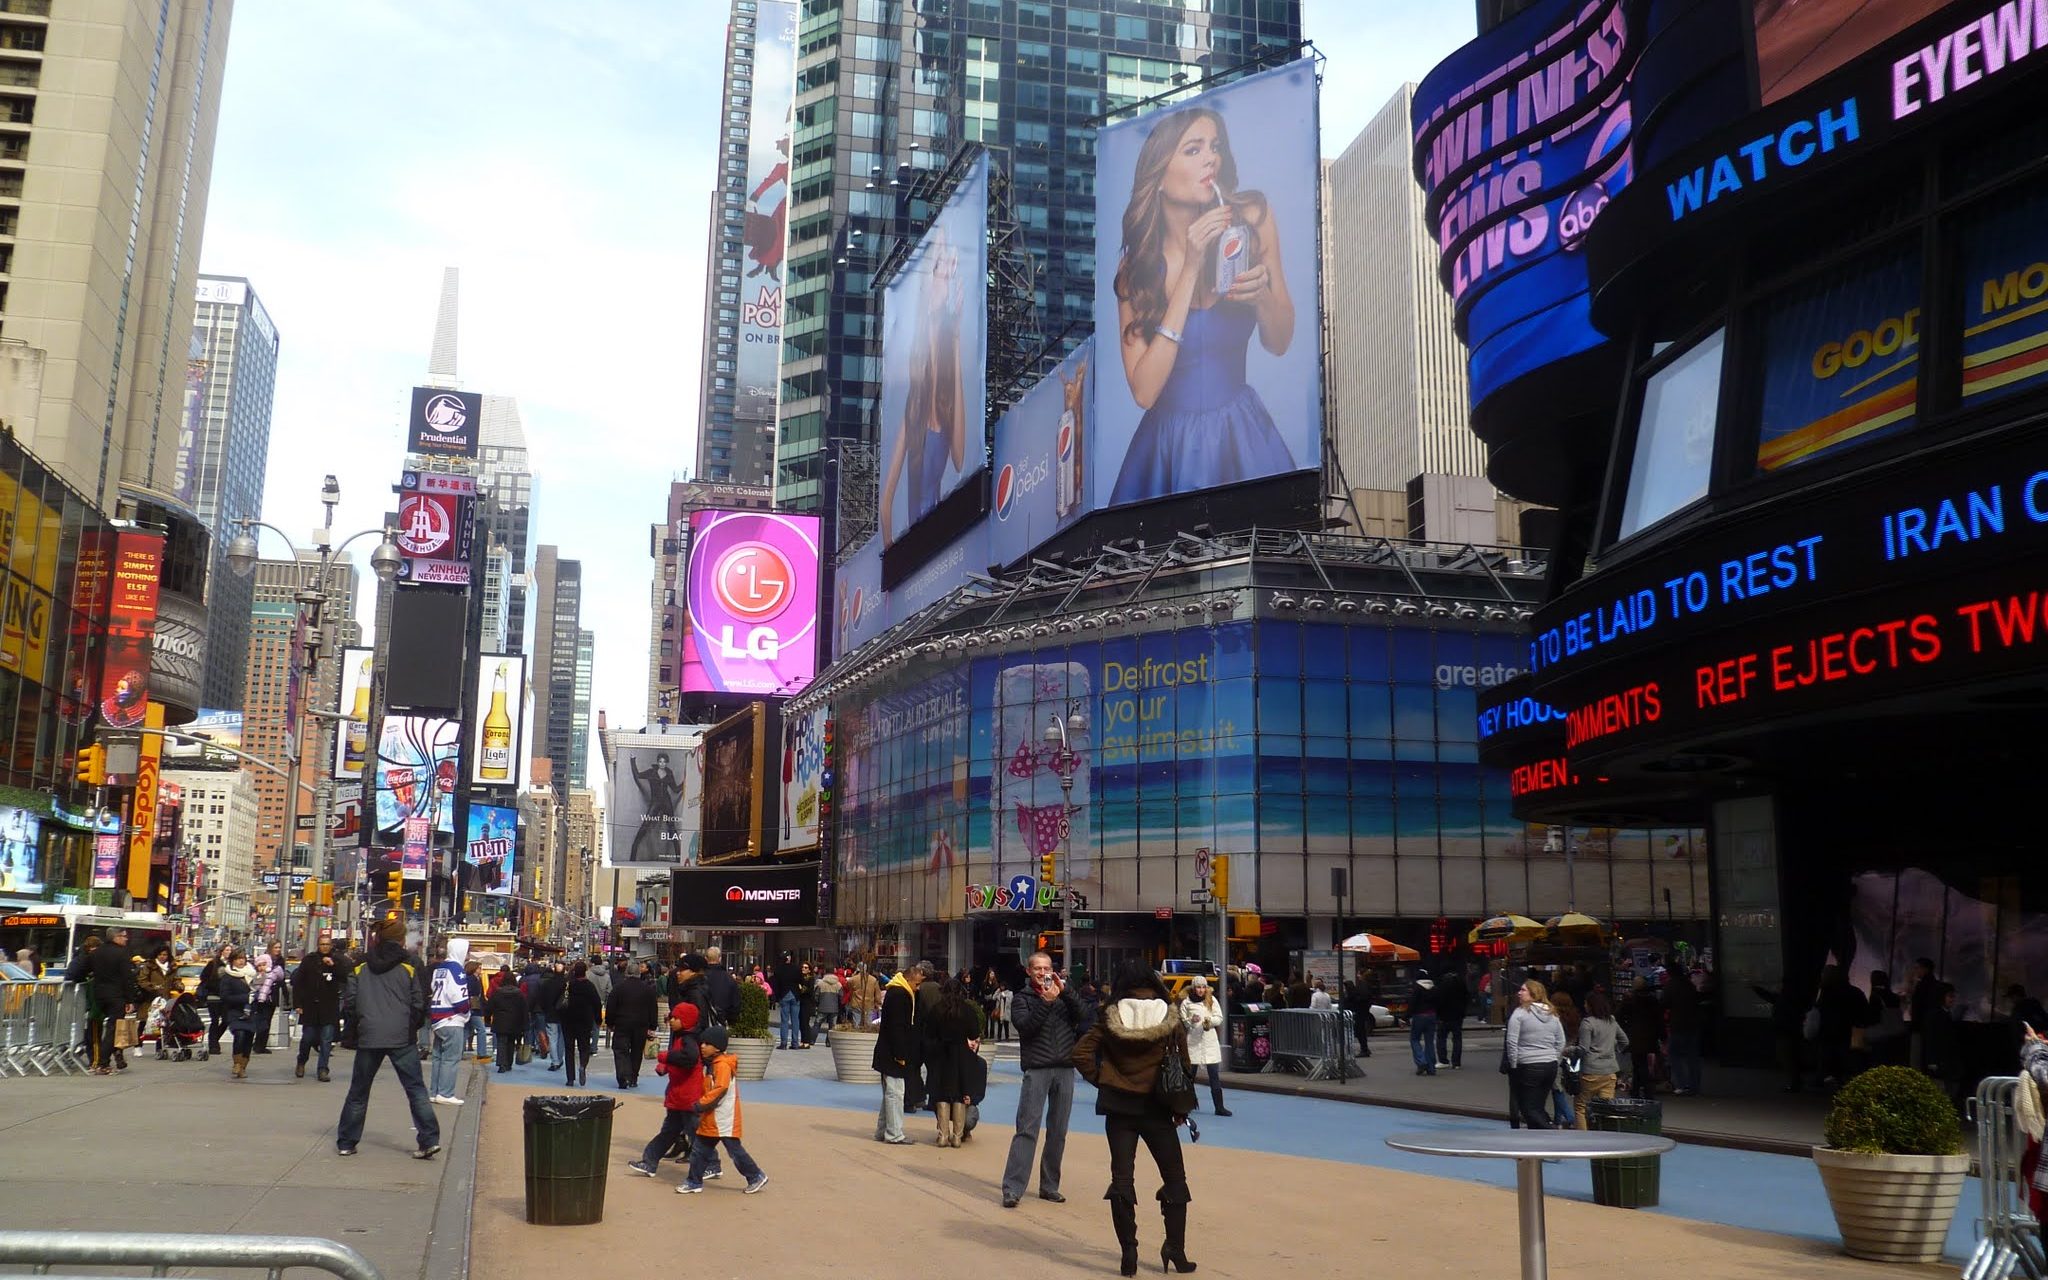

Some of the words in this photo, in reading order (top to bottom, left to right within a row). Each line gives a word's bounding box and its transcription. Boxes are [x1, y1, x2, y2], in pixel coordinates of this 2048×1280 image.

[1667, 97, 1860, 221] WATCH
[745, 333, 764, 343] ON
[420, 431, 467, 445] Prudential
[461, 500, 474, 559] XINHUA
[116, 571, 158, 582] NOTHING
[123, 561, 156, 571] SIMPLY
[413, 572, 441, 581] NEWS
[423, 563, 469, 575] XINHUA
[1539, 627, 1561, 669] TO
[1565, 612, 1594, 657] BE
[1597, 588, 1657, 644] LAID
[1664, 570, 1710, 620] TO
[1720, 535, 1825, 604] REST
[1882, 484, 2005, 561] IRAN
[126, 583, 148, 592] ELSE
[721, 625, 779, 660] LG
[1104, 653, 1207, 692] Defrost
[1697, 653, 1758, 709] REF
[1772, 614, 1942, 690] EJECTS
[1435, 662, 1529, 691] greate
[1105, 696, 1167, 732] your
[1104, 718, 1240, 760] swimsuit.
[133, 754, 160, 848] Kodak
[745, 889, 801, 901] MONSTER
[20, 917, 37, 925] SOUTH
